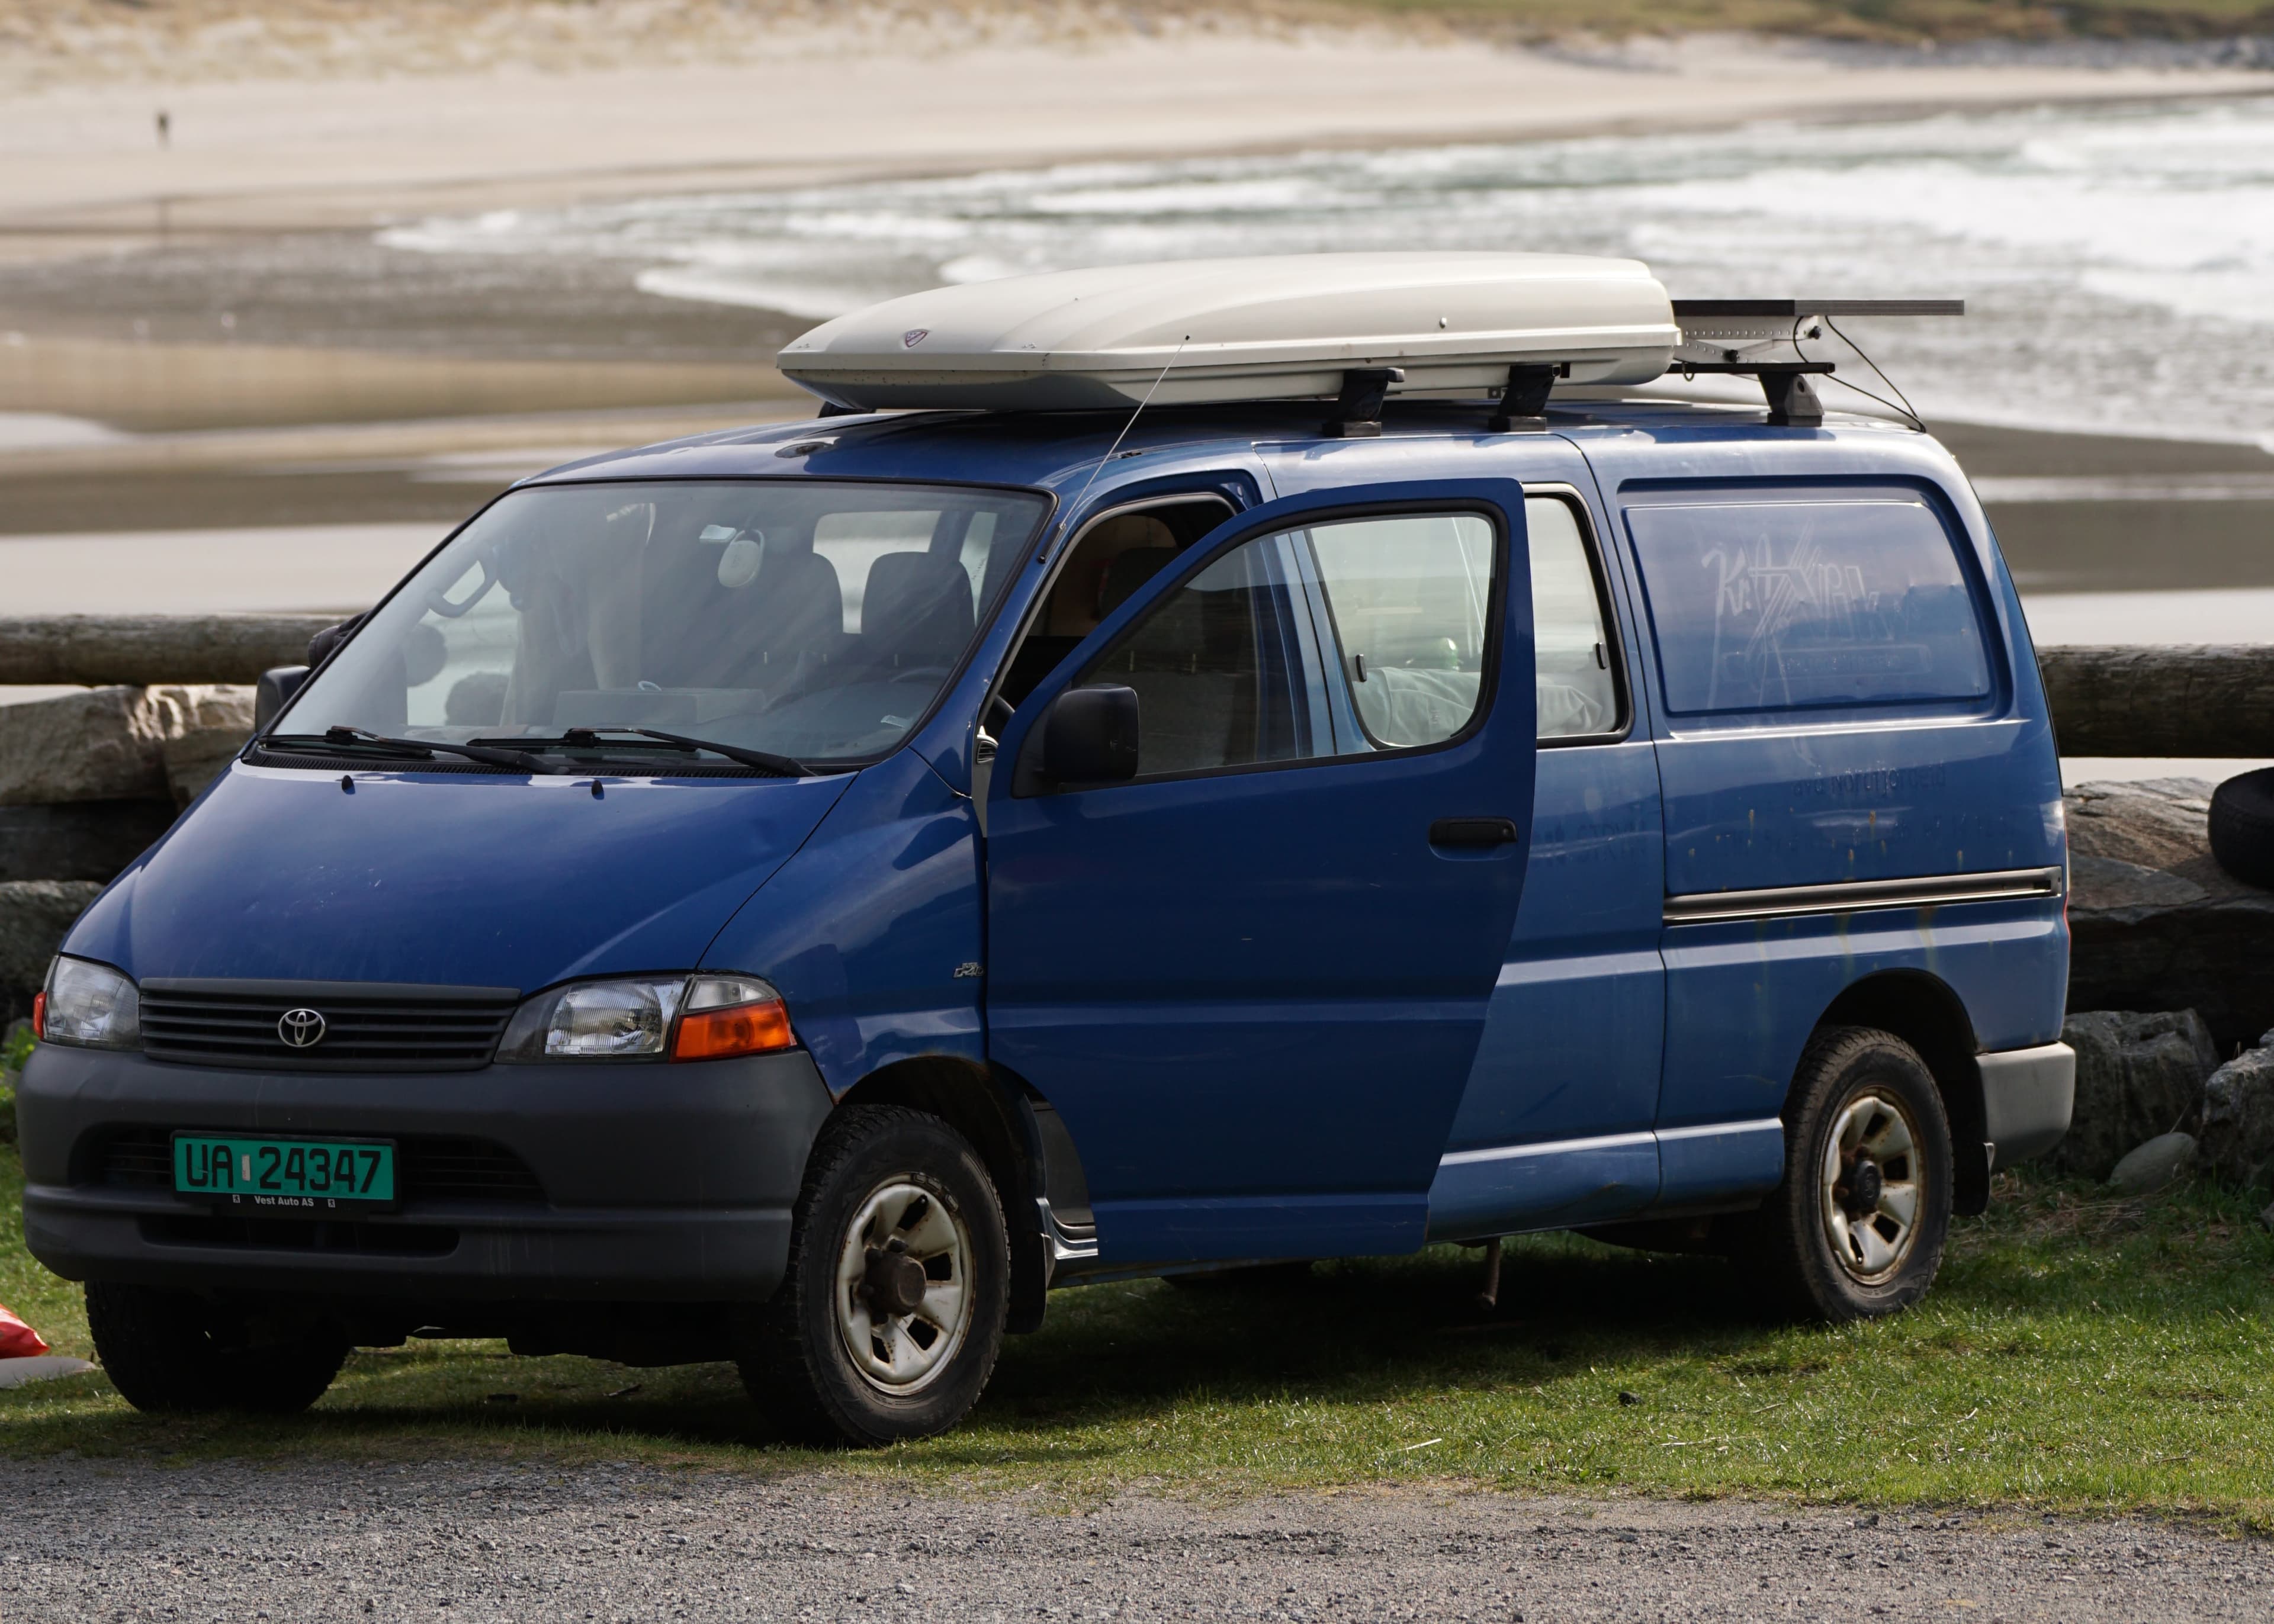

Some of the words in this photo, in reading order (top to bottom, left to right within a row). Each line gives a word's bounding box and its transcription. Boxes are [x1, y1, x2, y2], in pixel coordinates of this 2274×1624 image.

[186, 1144, 234, 1188] UA
[259, 1146, 381, 1193] 24347
[254, 1195, 275, 1205] Vest
[278, 1197, 299, 1206] Auto
[301, 1198, 314, 1207] AS
